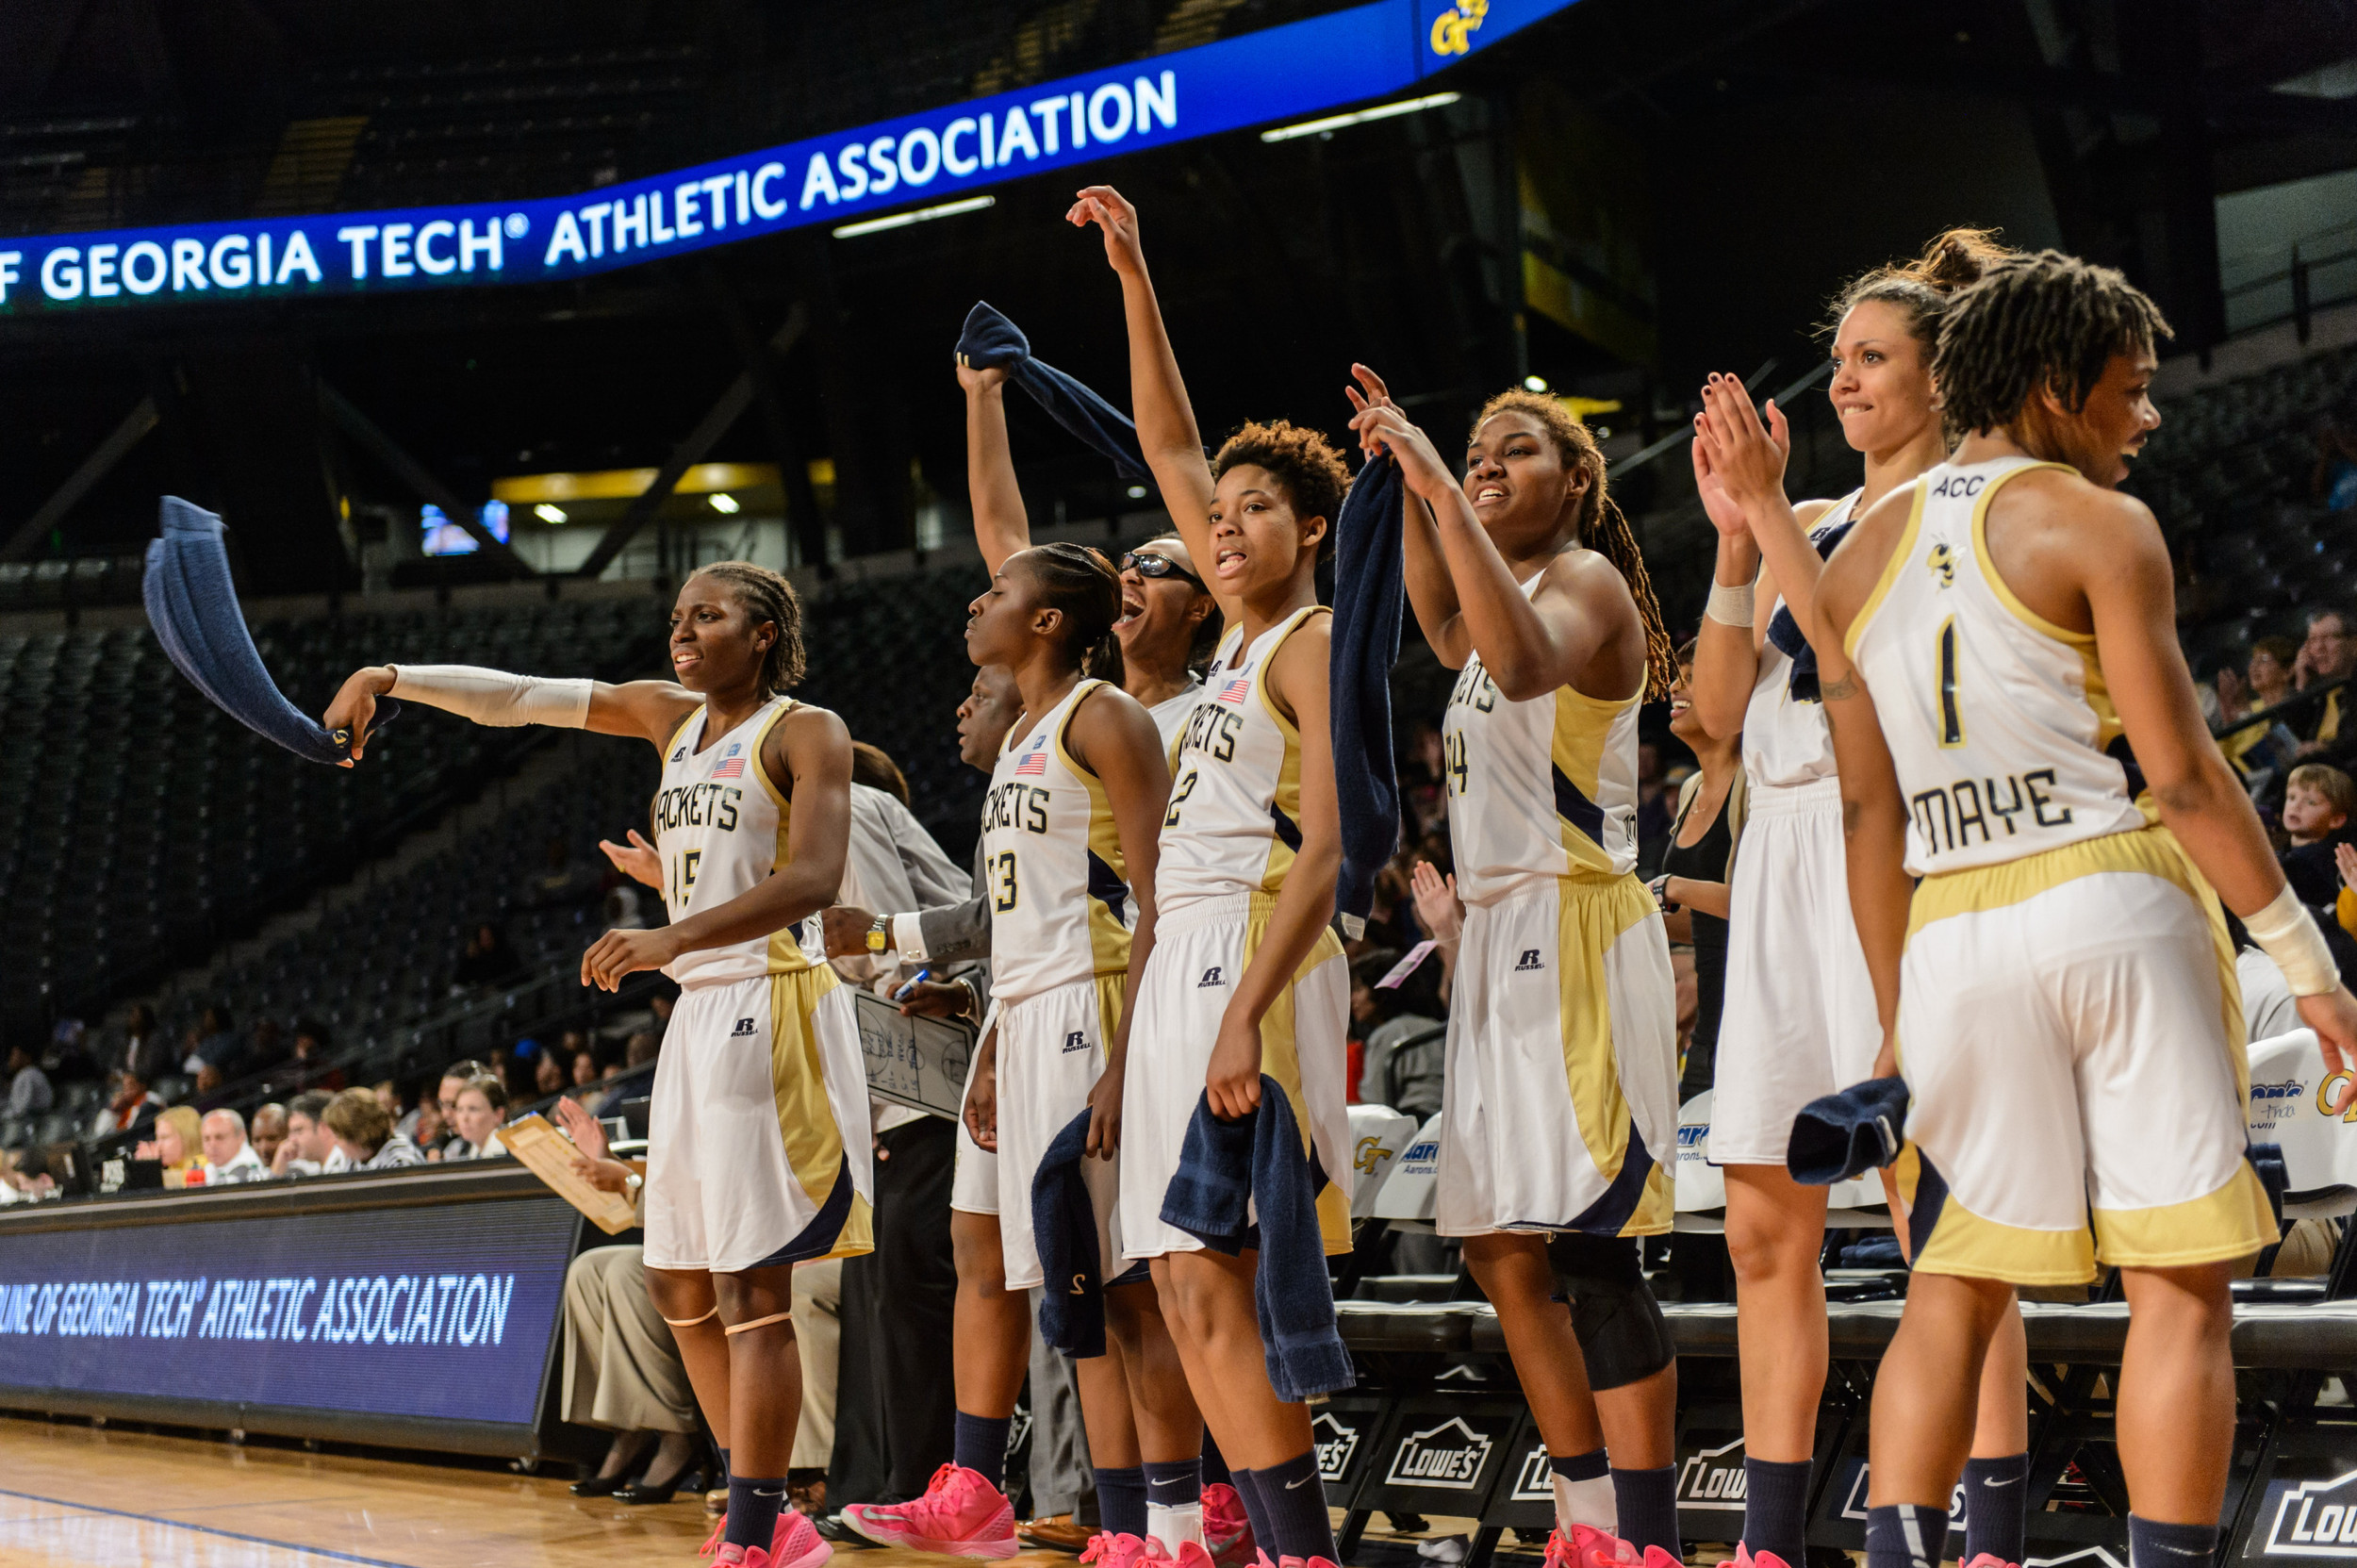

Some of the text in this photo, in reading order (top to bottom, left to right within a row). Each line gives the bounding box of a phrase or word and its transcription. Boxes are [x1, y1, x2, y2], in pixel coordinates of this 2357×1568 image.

[41, 230, 322, 301] GEORGIA
[544, 161, 788, 267] ATHLETIC
[799, 70, 1178, 210] ASSOCIATION
[1932, 475, 1985, 498] ACC
[1937, 616, 1966, 749] 1
[656, 783, 743, 833] ACKETS
[1913, 768, 2072, 857] MAYE
[1063, 1043, 1092, 1054] RUSSELL
[1354, 1136, 1393, 1175] GT
[0, 1284, 38, 1334] LINE
[33, 1283, 64, 1334] OF
[58, 1281, 140, 1337] GEORGIA
[198, 1277, 316, 1343] ATHLETIC
[310, 1273, 515, 1346] ASSOCIATION
[1401, 1443, 1477, 1479] LOWE'S
